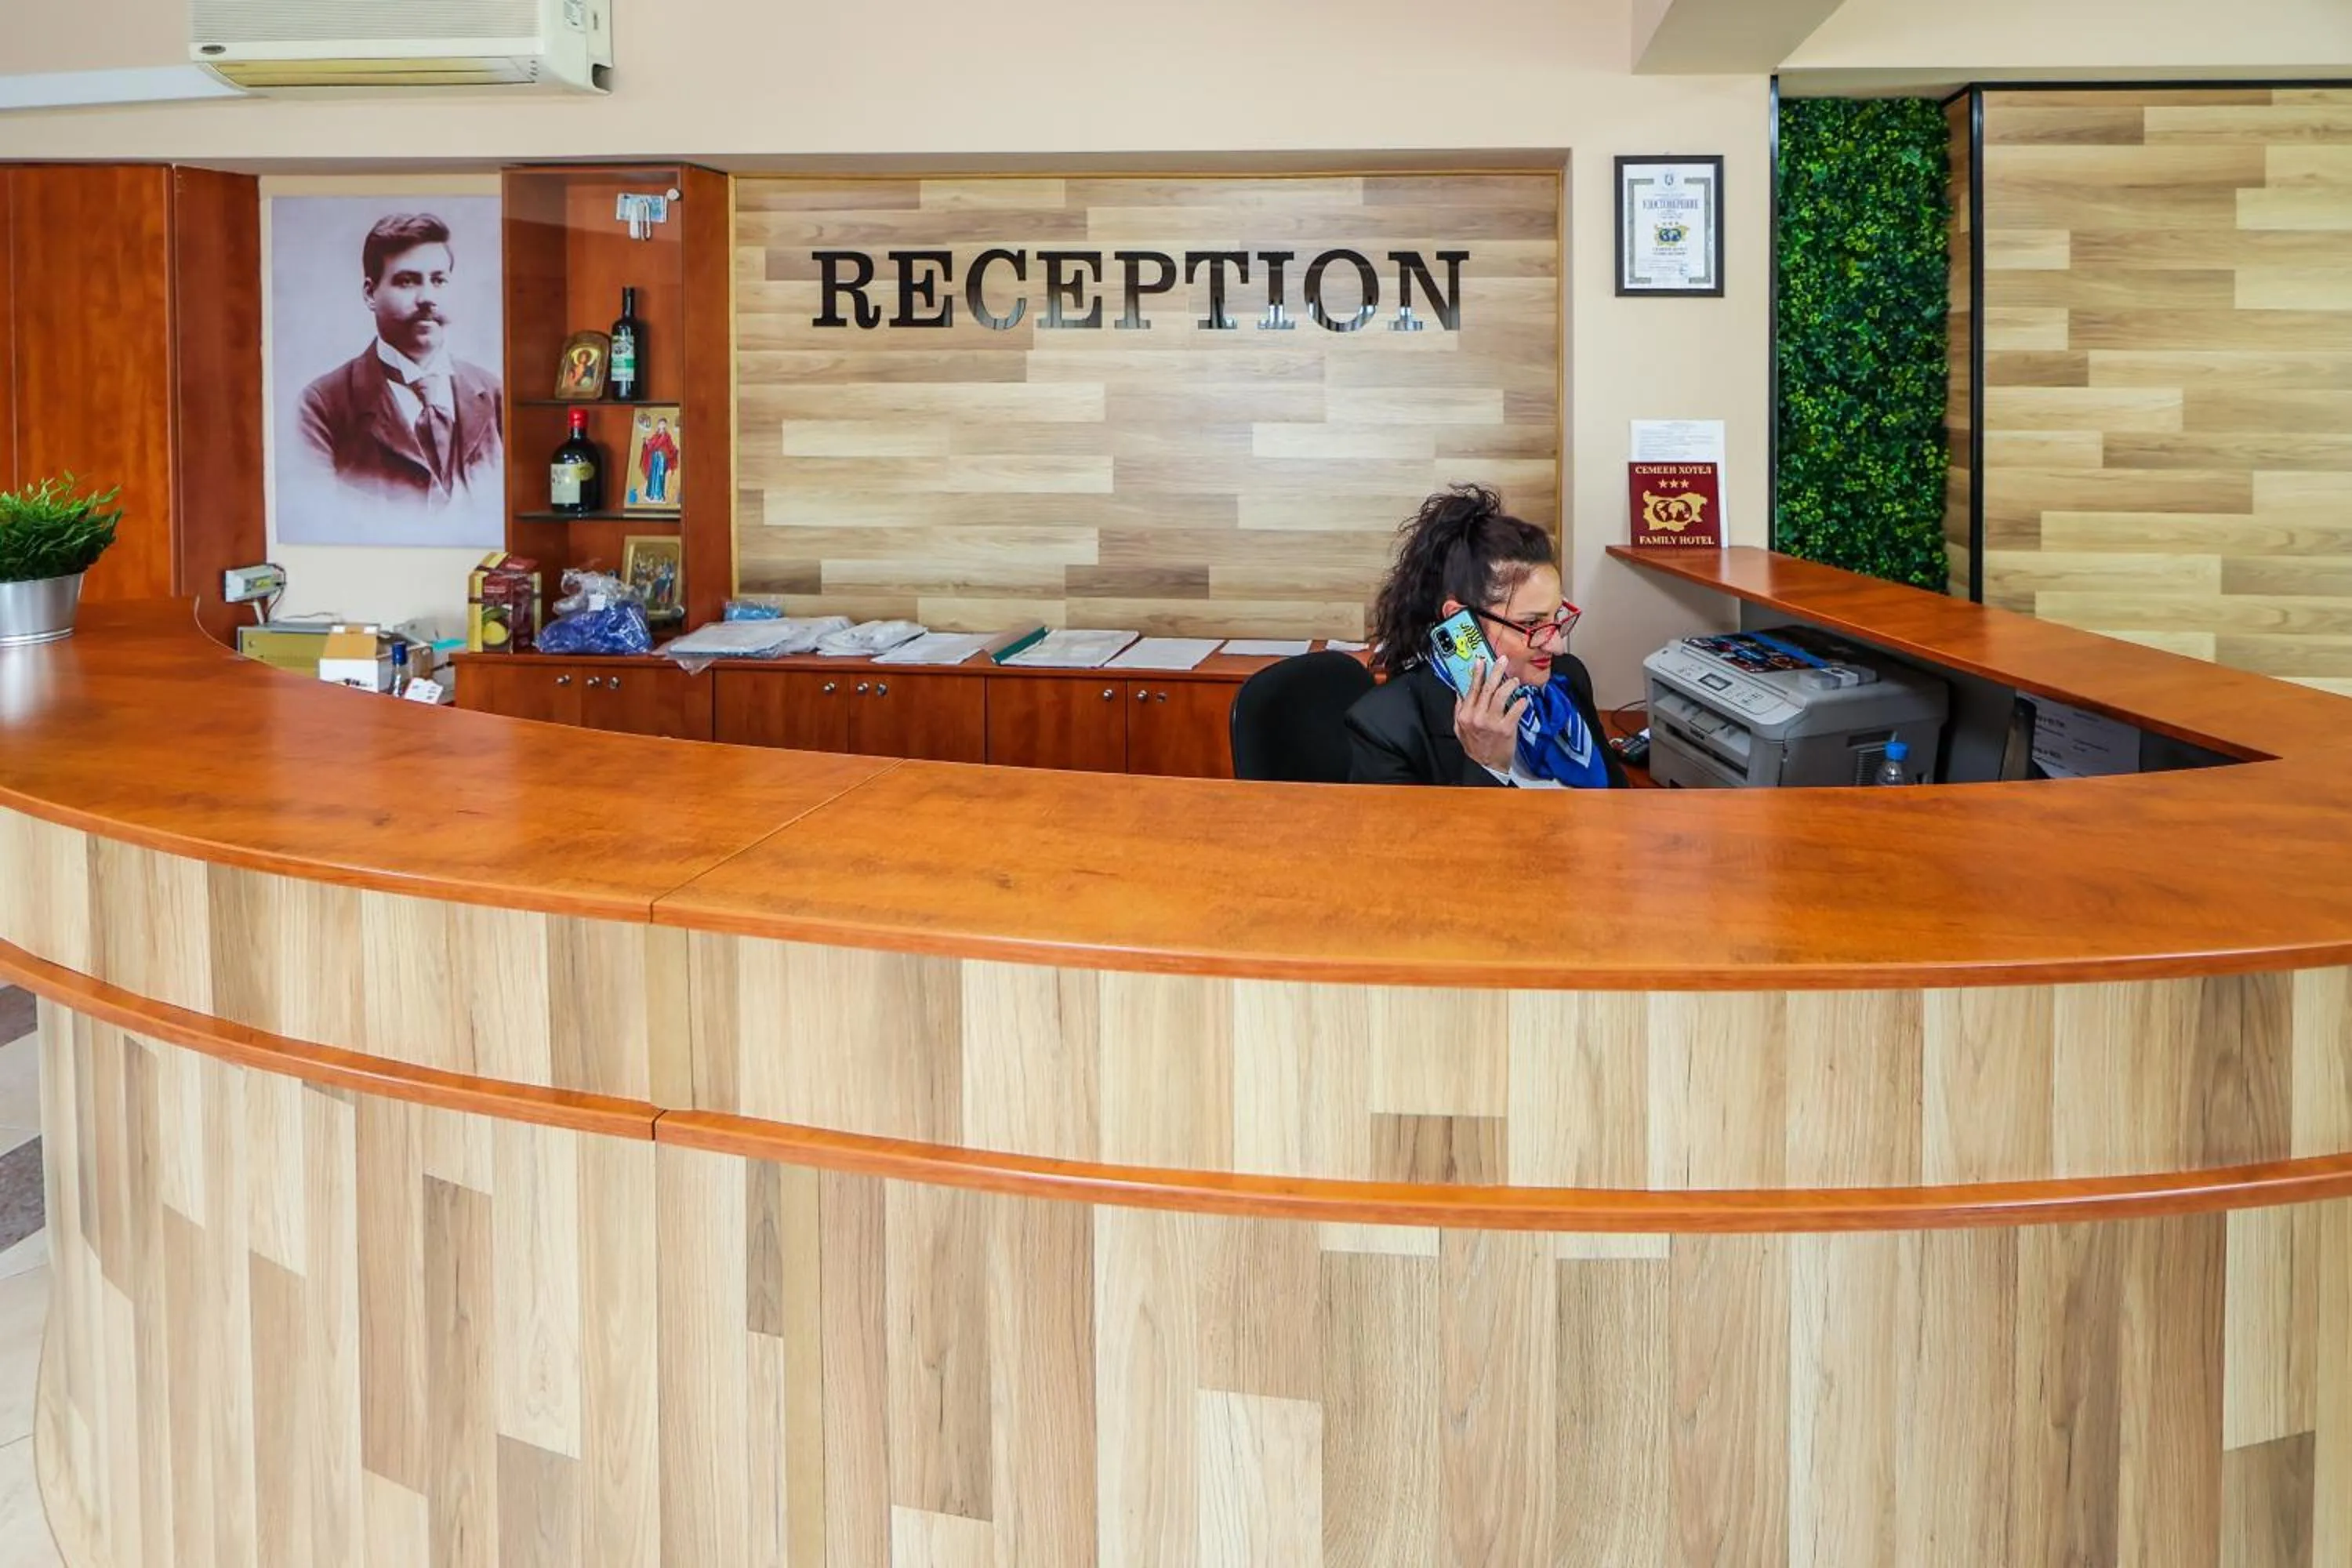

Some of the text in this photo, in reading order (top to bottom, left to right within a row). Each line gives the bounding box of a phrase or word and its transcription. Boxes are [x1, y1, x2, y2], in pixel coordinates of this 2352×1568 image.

[811, 249, 1470, 332] RECEPTION
[1635, 466, 1711, 474] СЕМЕЕН ХОТЕЛ
[1639, 535, 1715, 545] FAMILY HOTEL
